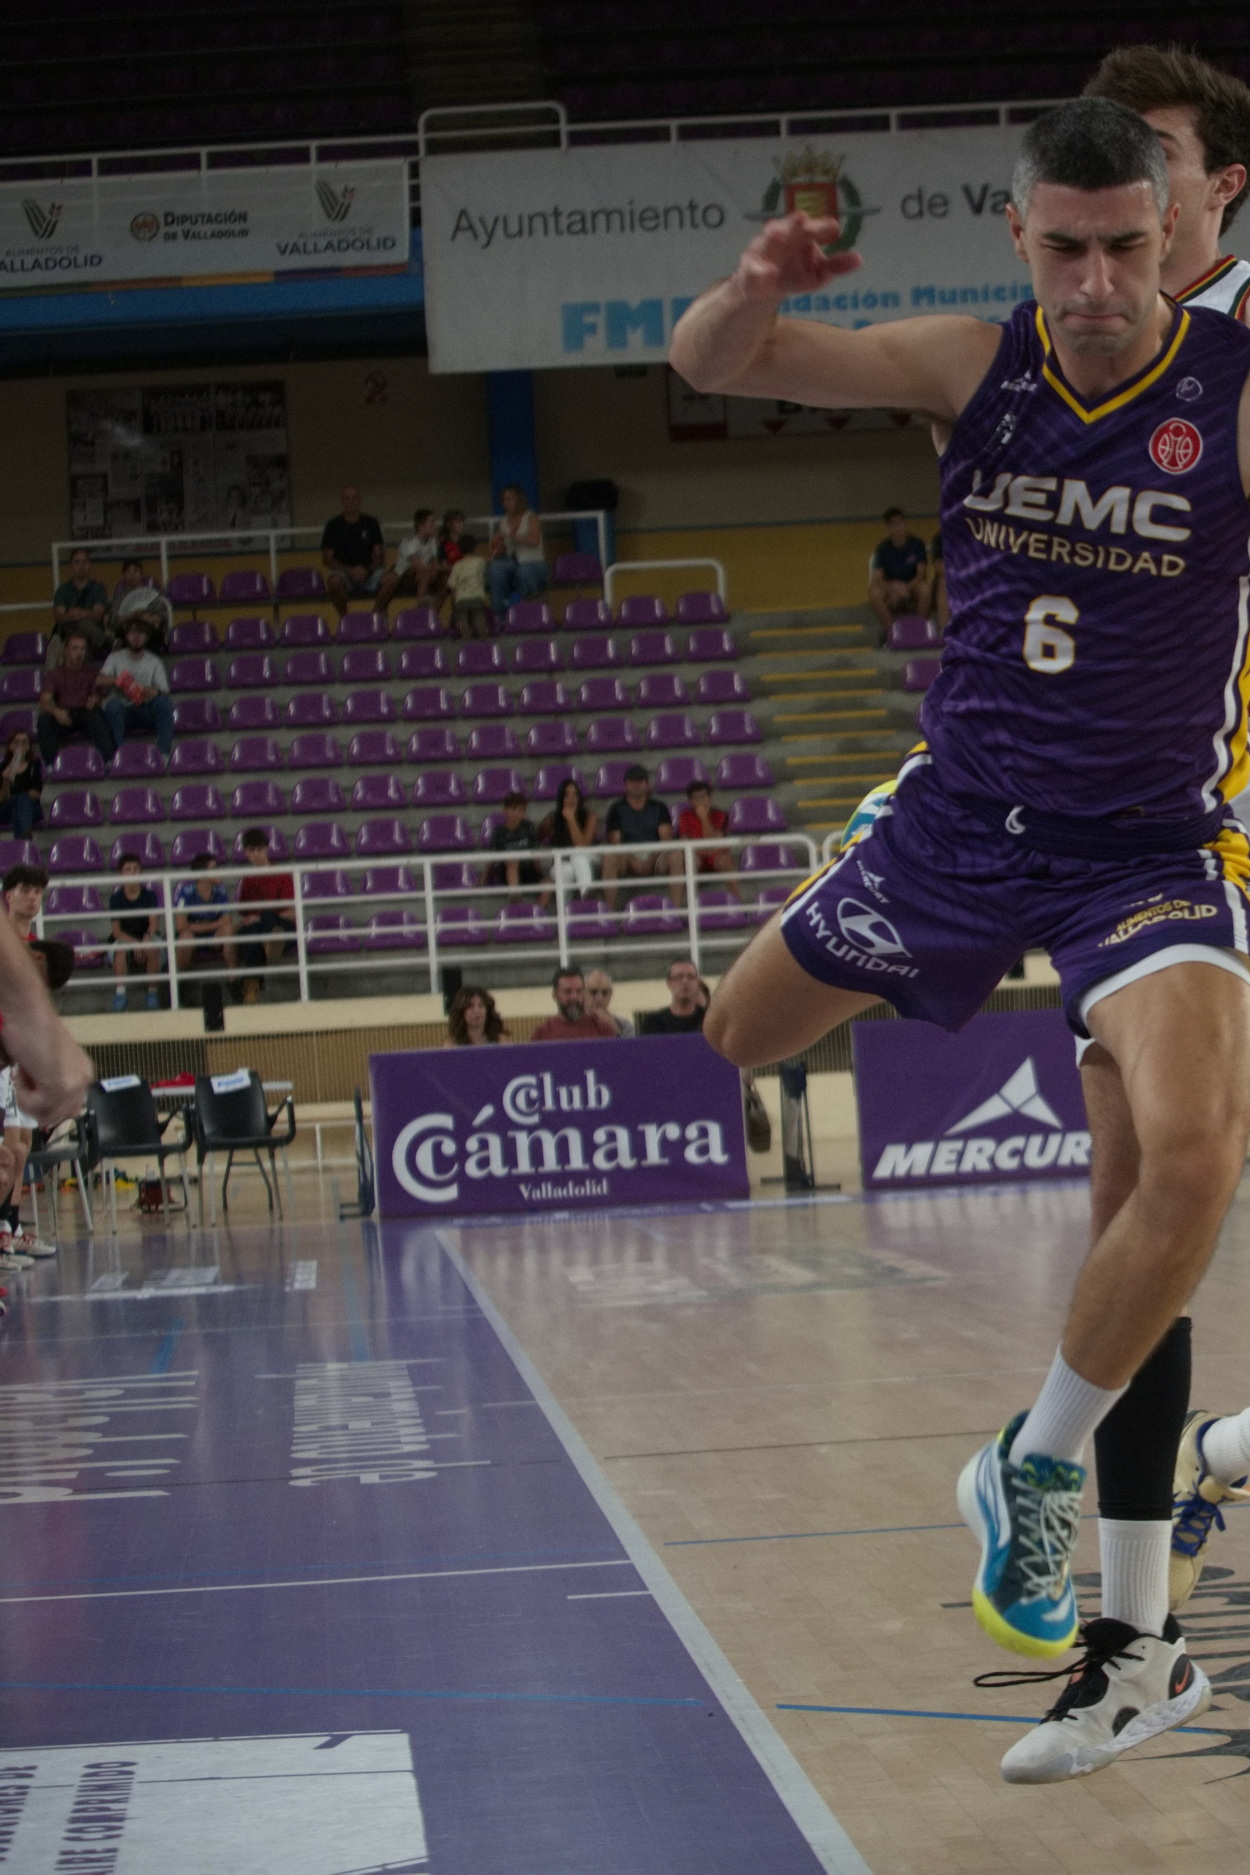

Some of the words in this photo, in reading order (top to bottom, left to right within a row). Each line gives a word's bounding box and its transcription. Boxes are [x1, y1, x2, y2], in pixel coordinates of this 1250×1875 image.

[163, 210, 248, 228] DIPUTACIÓN
[182, 226, 249, 241] VALLADOLID
[276, 235, 397, 257] VALLADOLID
[450, 198, 726, 250] Ayuntamiento
[902, 186, 950, 219] de
[0, 252, 103, 274] ALLADOLID
[962, 469, 1193, 543] UEMC
[965, 517, 1187, 578] UNIVERSIDAD
[1022, 594, 1081, 675] 6
[805, 901, 920, 979] HYUNDAI
[502, 1069, 610, 1125] Club
[392, 1104, 727, 1202] Cámara
[519, 1178, 608, 1201] Valladolid
[60, 1761, 139, 1841] COMPRIMIDO
